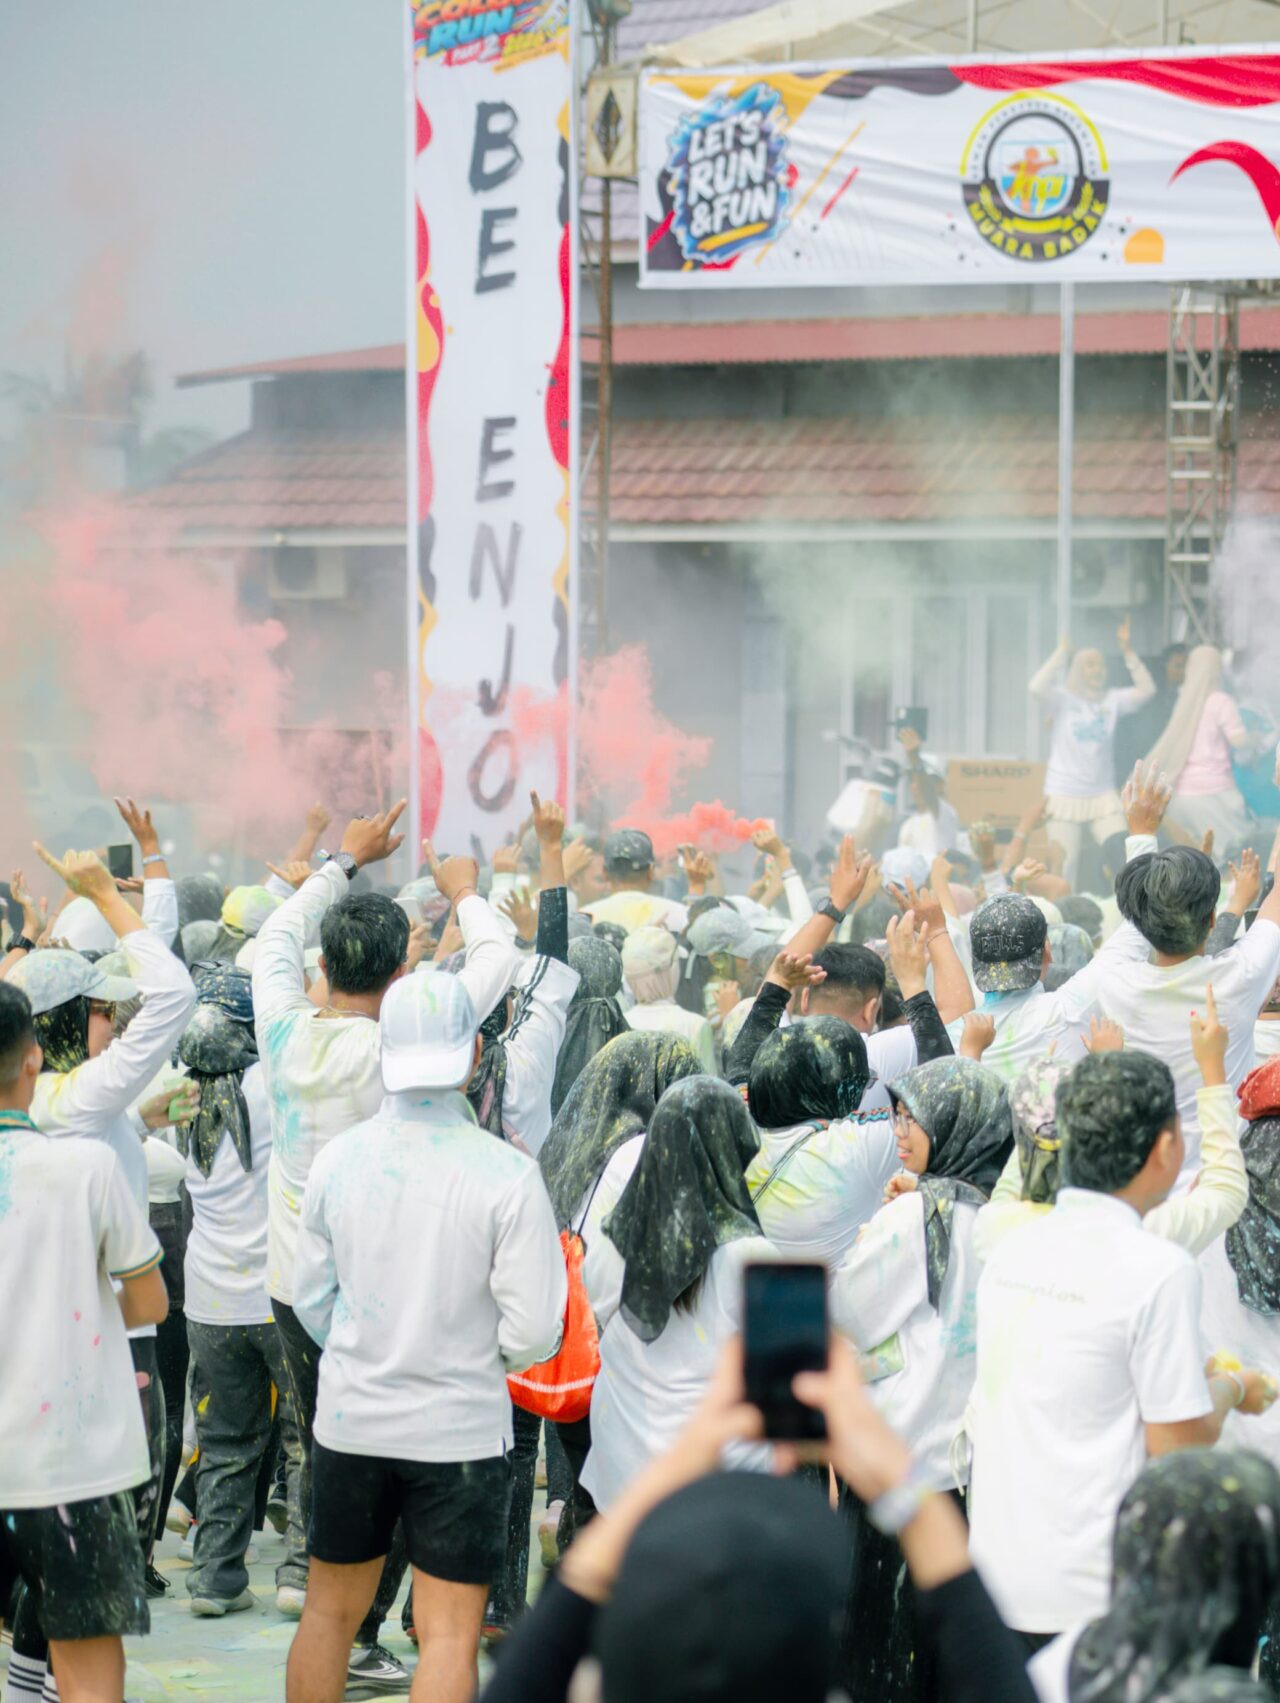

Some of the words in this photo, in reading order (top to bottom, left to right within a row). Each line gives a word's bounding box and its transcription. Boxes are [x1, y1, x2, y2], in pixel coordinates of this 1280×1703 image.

[427, 6, 515, 57] RUN
[687, 109, 765, 165] LET'S
[468, 100, 525, 295] BE
[687, 140, 769, 207] RUN
[689, 180, 778, 240] &FUN
[967, 200, 1034, 260] MUARA
[1042, 198, 1107, 260] BADAK
[960, 766, 1032, 779] SHARP
